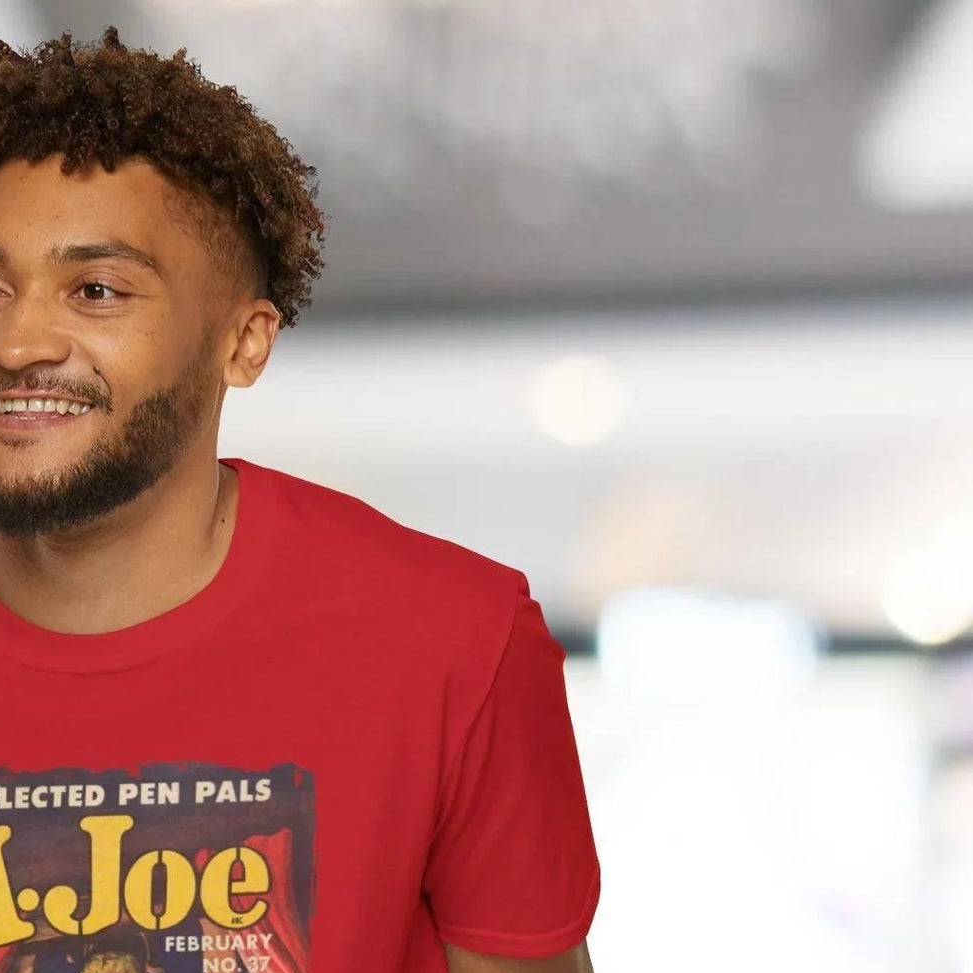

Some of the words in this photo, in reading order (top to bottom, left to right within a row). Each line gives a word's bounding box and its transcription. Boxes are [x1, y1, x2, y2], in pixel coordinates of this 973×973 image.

[119, 782, 179, 806] PEN
[195, 779, 271, 804] PALS
[165, 933, 273, 952] FEBRUARY
[203, 957, 242, 973] NO.
[247, 955, 270, 972] 37
